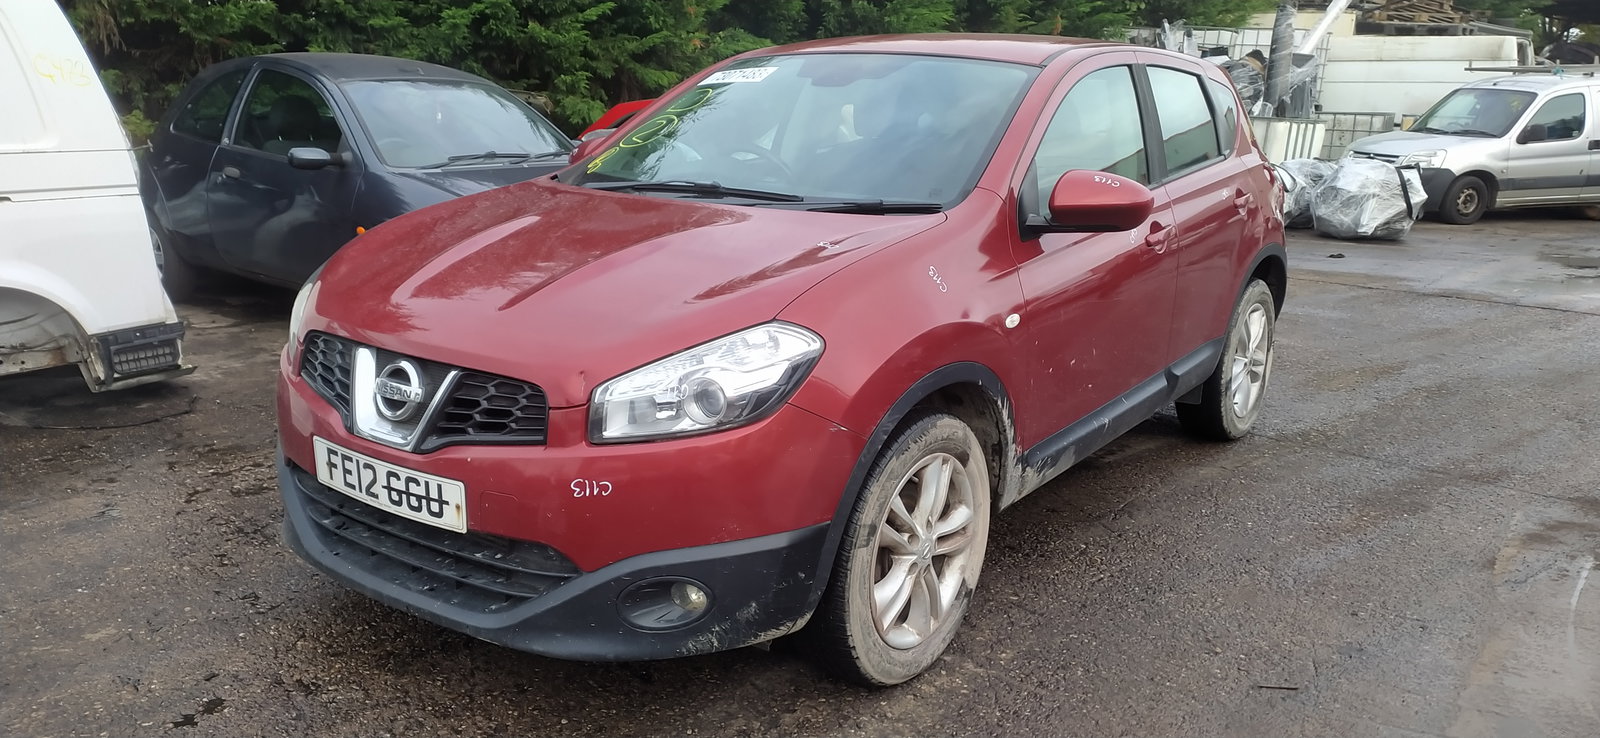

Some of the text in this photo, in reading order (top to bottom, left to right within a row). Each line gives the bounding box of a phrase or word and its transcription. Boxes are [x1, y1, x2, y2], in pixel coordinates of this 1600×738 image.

[376, 379, 412, 400] NISSAN
[326, 447, 379, 500] FE12
[570, 478, 612, 498] C113
